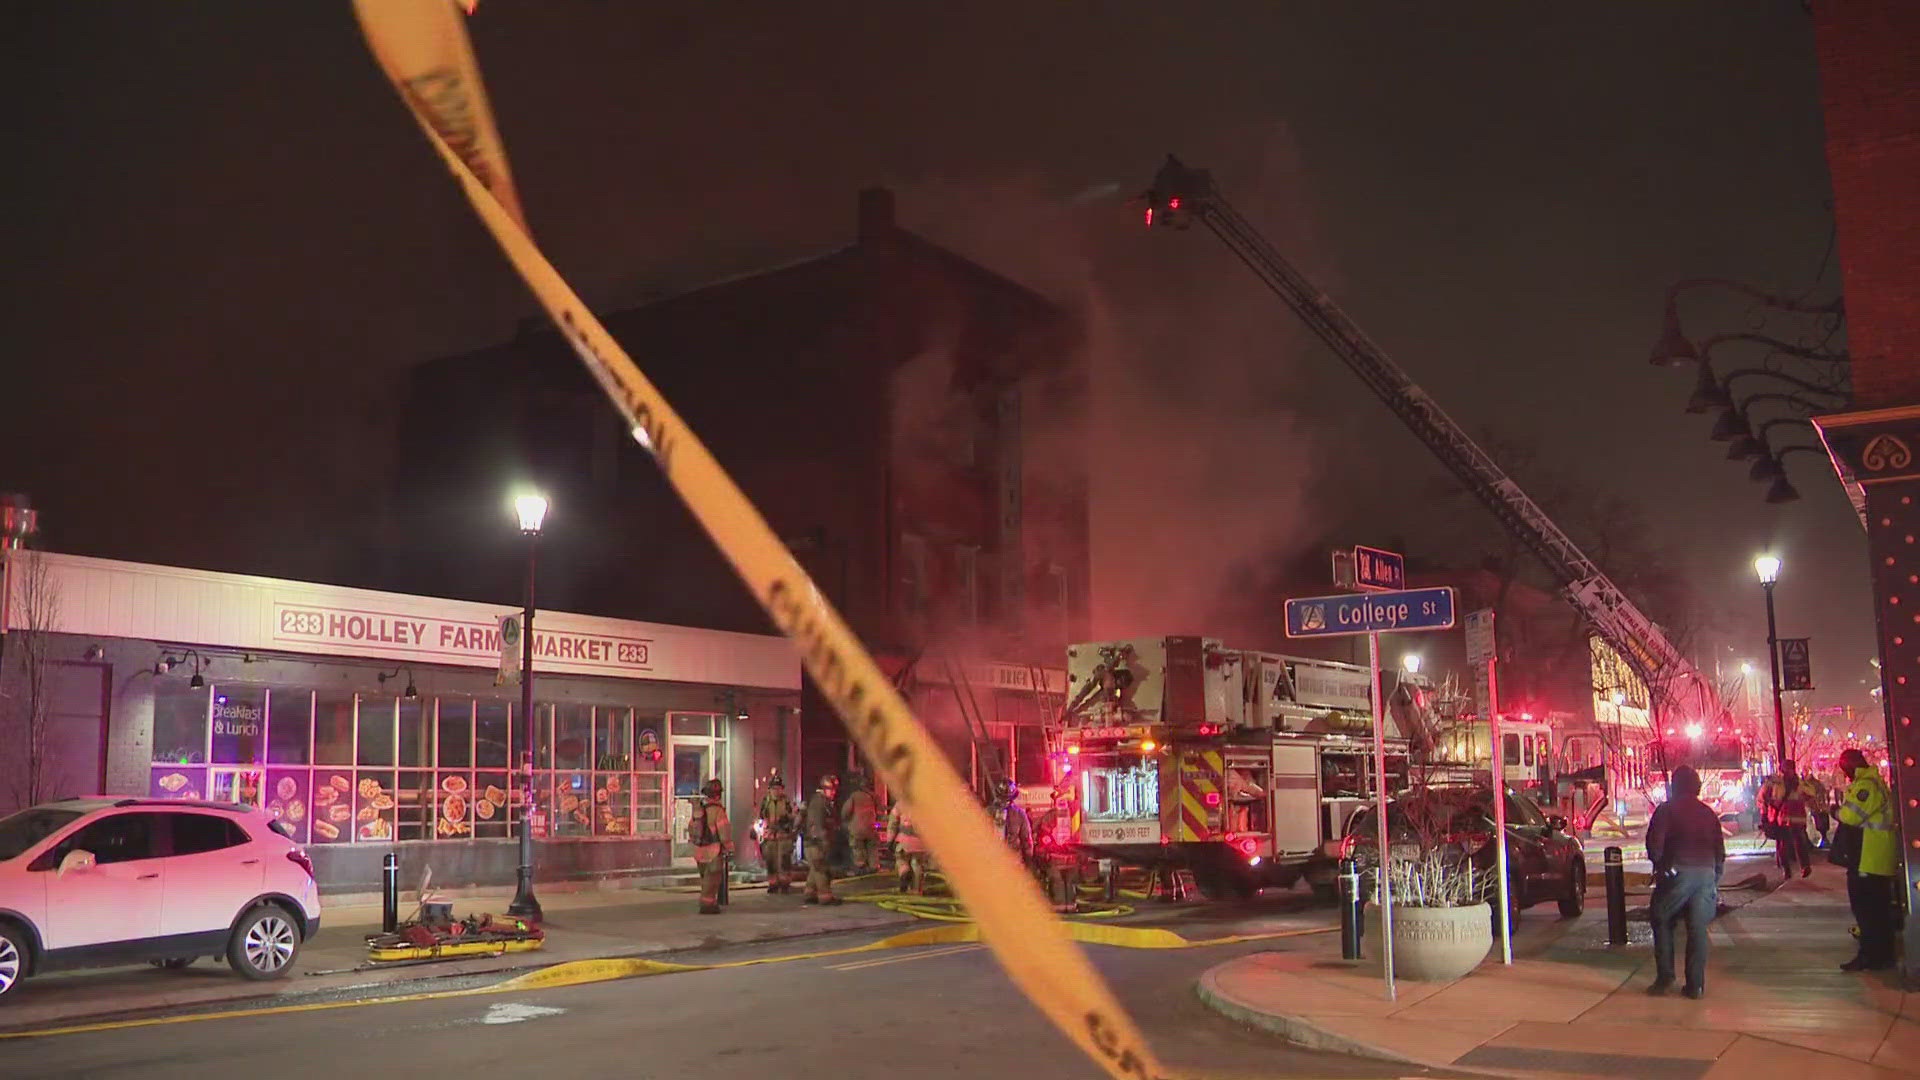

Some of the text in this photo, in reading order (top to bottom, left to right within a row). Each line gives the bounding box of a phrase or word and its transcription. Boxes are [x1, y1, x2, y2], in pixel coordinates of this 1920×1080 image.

[1375, 558, 1393, 584] Allen
[1338, 602, 1408, 629] College
[1422, 601, 1437, 615] St
[283, 611, 647, 663] 233 HOLLEY FARM MARKET 233
[213, 704, 260, 721] Breakfast
[214, 721, 259, 736] & Lunch
[1137, 825, 1151, 838] FEET
